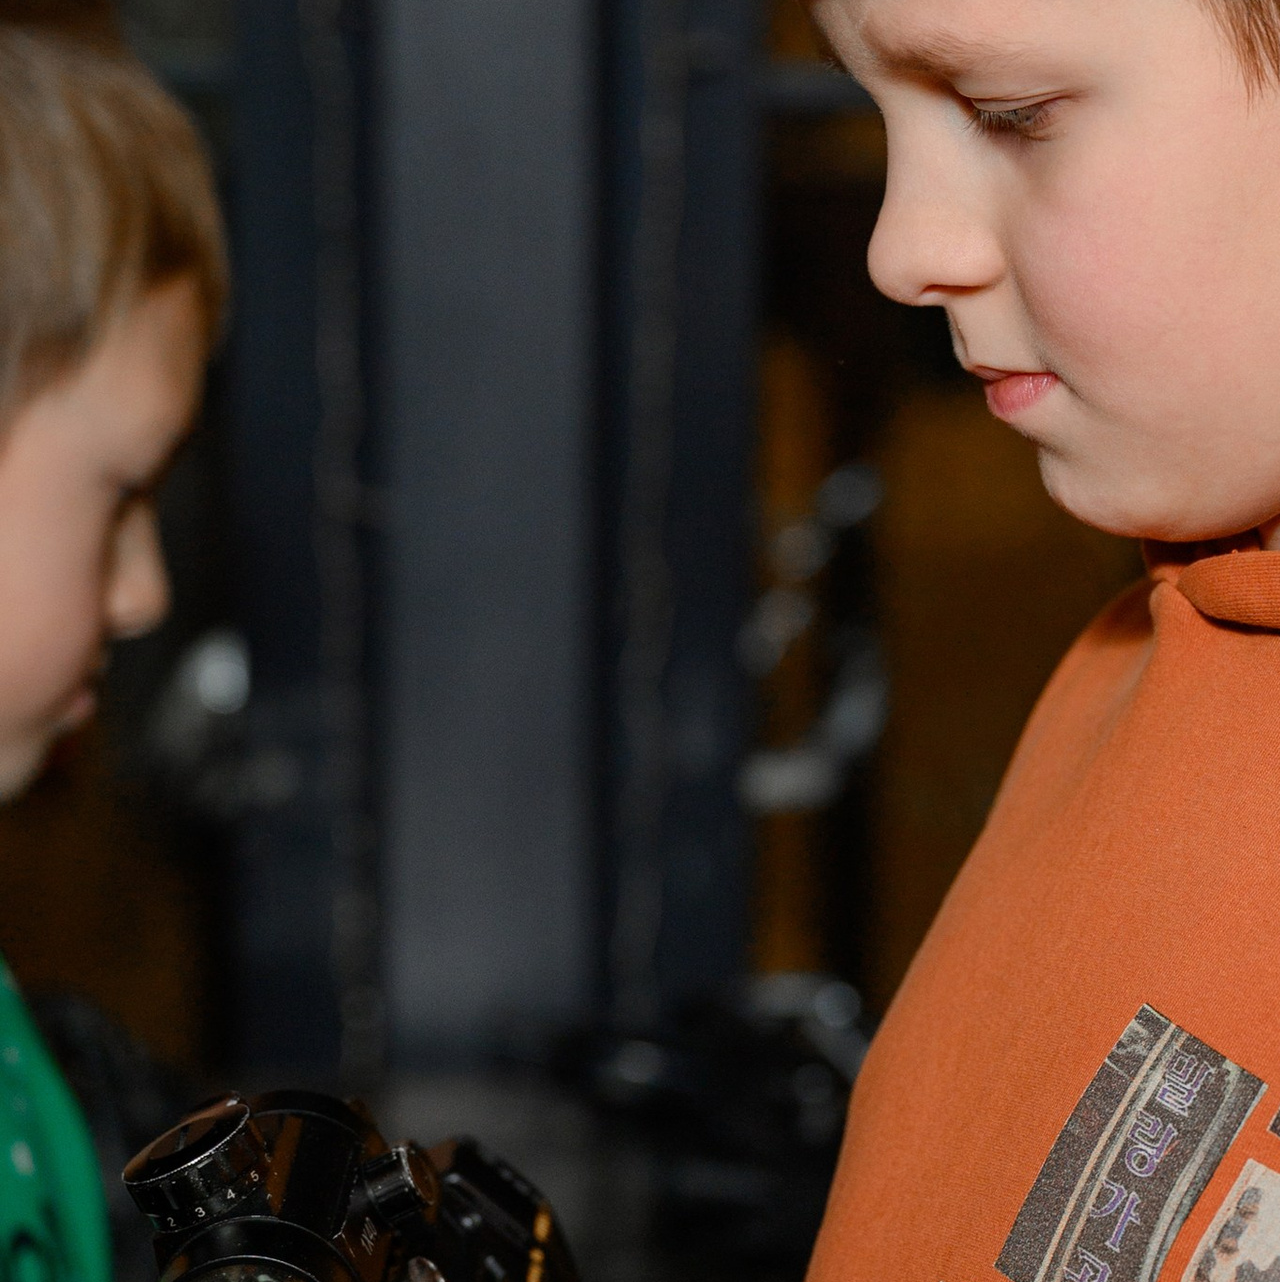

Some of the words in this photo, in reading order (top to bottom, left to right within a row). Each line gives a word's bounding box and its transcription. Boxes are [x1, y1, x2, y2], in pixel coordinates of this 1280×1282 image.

[166, 1216, 177, 1228] 2
[194, 1206, 206, 1218] 3
[226, 1188, 236, 1200] 4
[250, 1170, 260, 1182] 5
